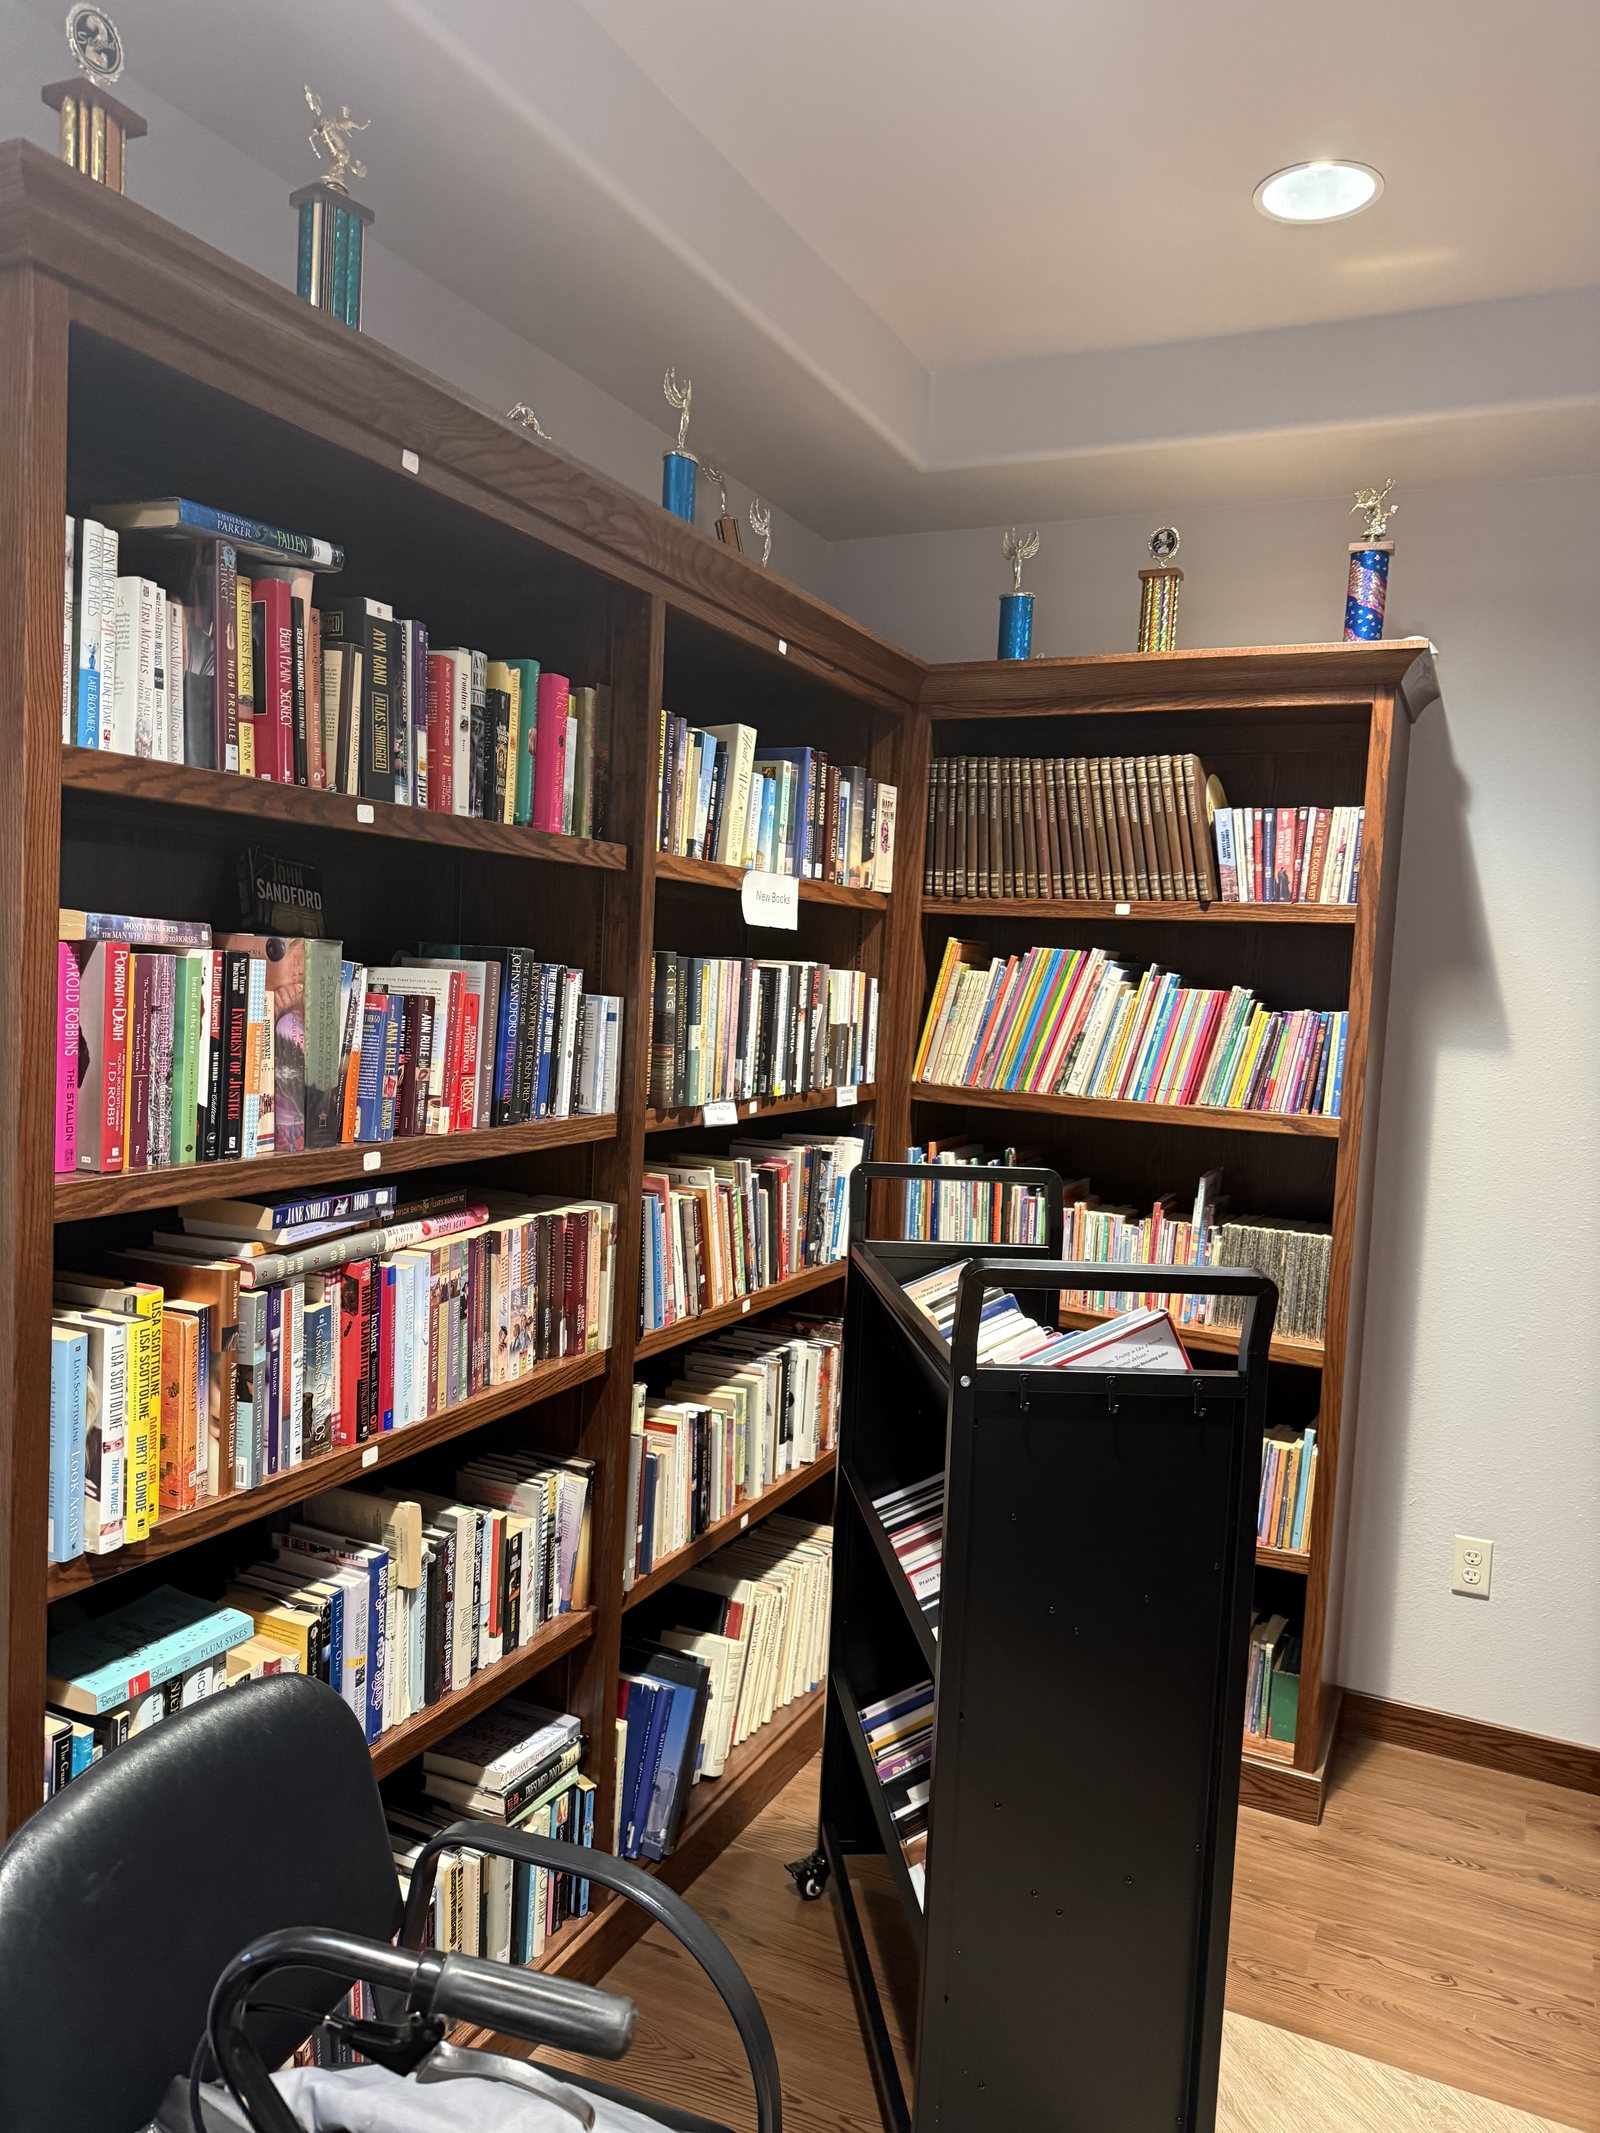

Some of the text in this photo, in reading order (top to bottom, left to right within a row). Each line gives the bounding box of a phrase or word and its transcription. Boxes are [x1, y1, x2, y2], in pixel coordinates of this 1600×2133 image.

[217, 519, 252, 539] PARKER
[276, 530, 308, 555] FALLEN
[87, 532, 103, 617] FERN MICHAELS
[102, 535, 117, 616] FERN MICHAELS
[240, 582, 251, 607] HER
[104, 640, 114, 652] NO
[139, 601, 152, 676] FERN MICHAELS
[373, 628, 387, 687] AYN RAND
[241, 656, 252, 693] HOUSE
[279, 627, 293, 728] BELVA PLAIN SECRECY
[297, 660, 305, 690] WALKING
[85, 675, 98, 735] LATE BLOOMER
[102, 700, 112, 727] HOME
[227, 659, 237, 741] HIGH PROFILE
[443, 681, 452, 747] KATHY REICHS
[242, 741, 252, 761] PLAIN
[375, 696, 388, 770] ATLAS SHRUGGED
[819, 792, 827, 826] WOODS
[831, 803, 839, 825] WOUK
[829, 838, 837, 863] GLORY
[256, 877, 322, 910] SANDFORD
[756, 890, 791, 906] New Books
[111, 931, 198, 944] MAN HORSES
[123, 921, 148, 933] MONTY
[113, 950, 128, 998] PORTRAIT
[191, 976, 199, 994] bend
[665, 964, 675, 1010] KING
[64, 952, 80, 1057] HAROLD ROBBINS
[116, 998, 123, 1008] IN
[191, 997, 198, 1010] of
[210, 965, 222, 1033] Elliott Roosevelt
[507, 952, 521, 1038] JOHN SANDFORD
[112, 1009, 126, 1041] DEATH
[189, 1031, 197, 1055] river
[419, 1013, 432, 1057] ANN RULE
[468, 1025, 477, 1062] EDWARD
[227, 1007, 245, 1120] INTEREST OF JUSTICE
[385, 1020, 399, 1074] ANN RULE
[522, 994, 538, 1104] SANDFORD CHOSEN PREY
[503, 1040, 517, 1106] HIDDEN PREY
[65, 1068, 75, 1142] THE STALLION
[460, 1076, 475, 1113] RUSSKA
[285, 1200, 331, 1224] JANE SMILEY
[352, 1193, 369, 1211] MOO
[370, 1273, 380, 1354] Isolated Incident
[149, 1300, 163, 1398] LISA SCOTTOLINE
[314, 1327, 322, 1381] SIMMONS
[320, 1339, 329, 1364] DAN
[370, 1357, 378, 1380] Susan
[109, 1343, 124, 1432] LISA SCOTTOLINE
[229, 1369, 237, 1411] WEDDING
[135, 1327, 151, 1513] LISA SCOTTOLINE DIRTY BLONDE
[229, 1412, 235, 1422] IN
[69, 1358, 82, 1544] LISA SCOTTOLINE LOOK AGAIN
[228, 1423, 236, 1469] DECEMBER
[110, 1458, 120, 1515] THINK TWICE
[918, 1575, 936, 1587] Praise
[200, 1628, 248, 1658] PLUM SYKES
[332, 1596, 343, 1672] The Lucky One
[60, 1740, 70, 1759] The
